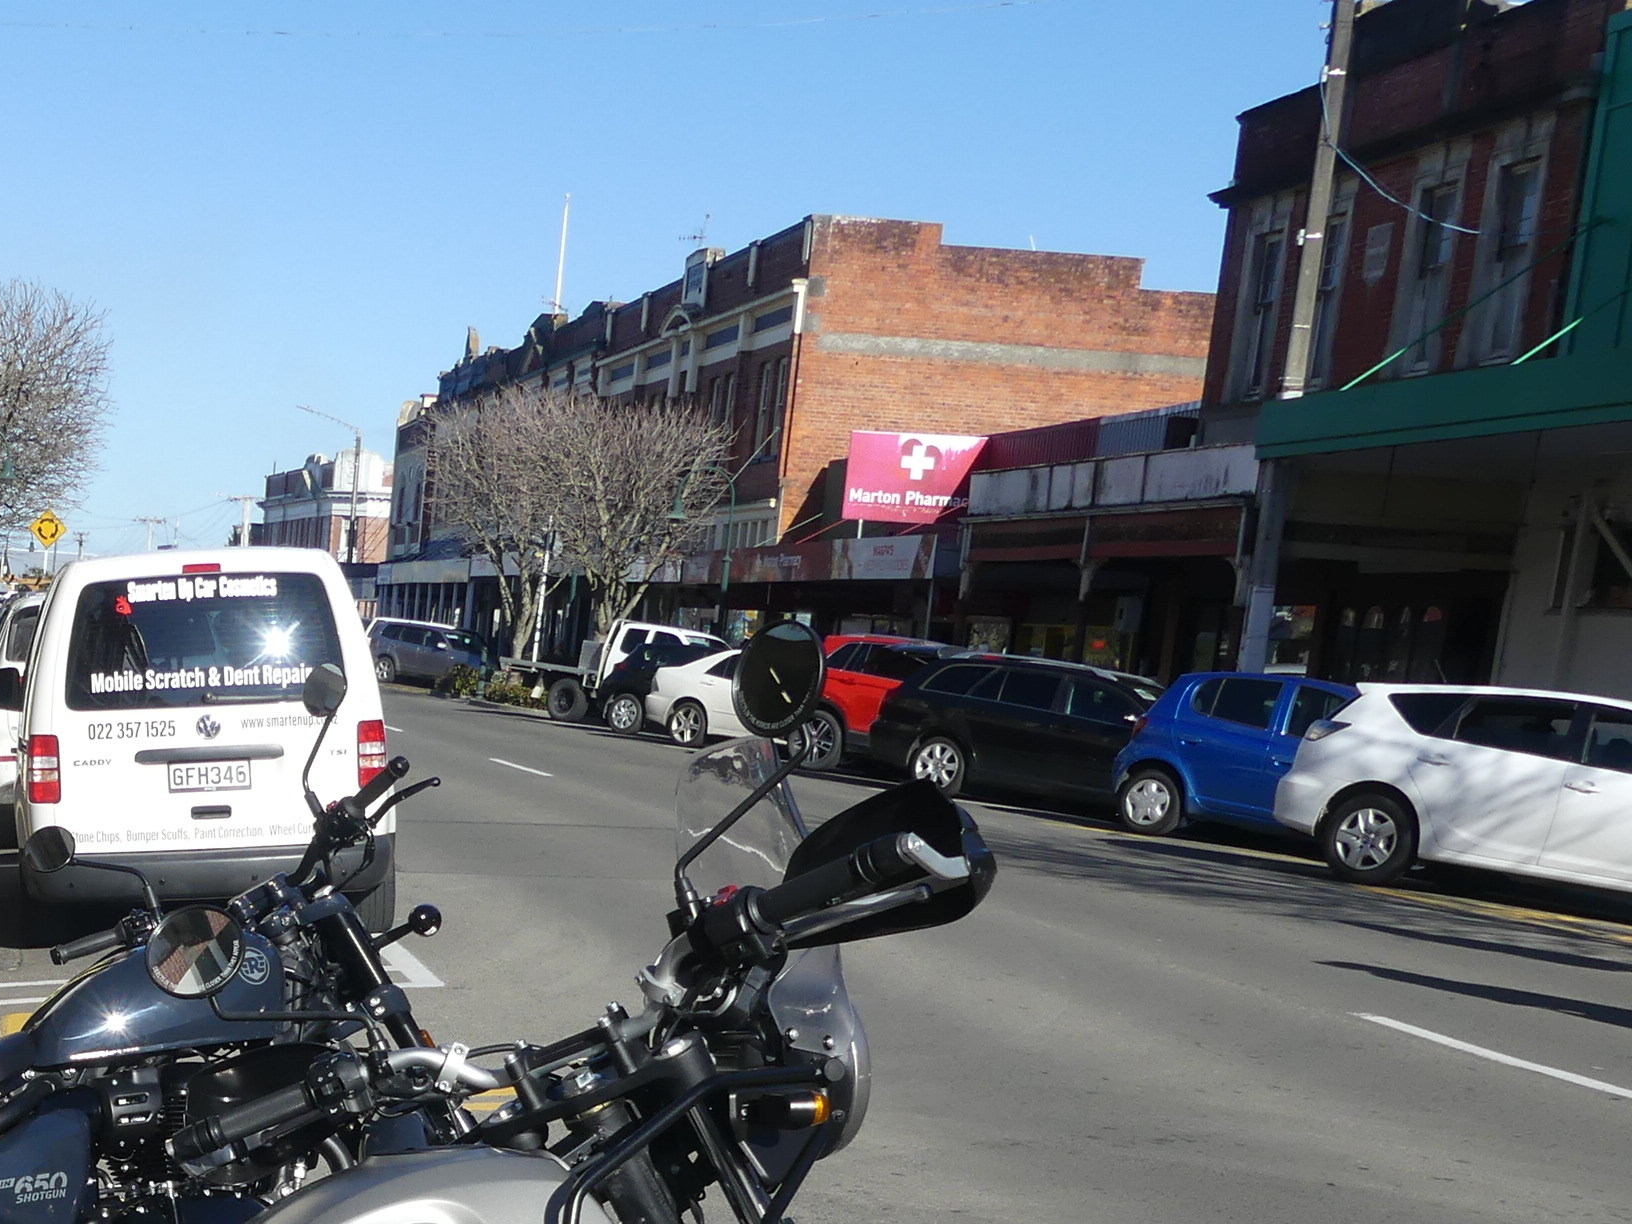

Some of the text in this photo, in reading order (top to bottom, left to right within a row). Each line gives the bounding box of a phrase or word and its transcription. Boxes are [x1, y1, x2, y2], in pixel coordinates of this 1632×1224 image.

[849, 487, 969, 508] Marton Pharmac
[127, 575, 277, 603] Smarten Up Car Cosmetics
[91, 670, 143, 693] Mobile
[145, 667, 205, 690] Scratch
[208, 666, 221, 687] &
[223, 666, 260, 686] Dent
[88, 720, 176, 740] 022 357 1525
[73, 758, 112, 767] CADDY
[172, 765, 247, 786] GFH346
[126, 830, 160, 844] Bumper
[194, 828, 216, 840] Paint
[269, 824, 295, 836] Wheel
[14, 1171, 68, 1194] 650
[15, 1188, 67, 1204] SHOTGUN
